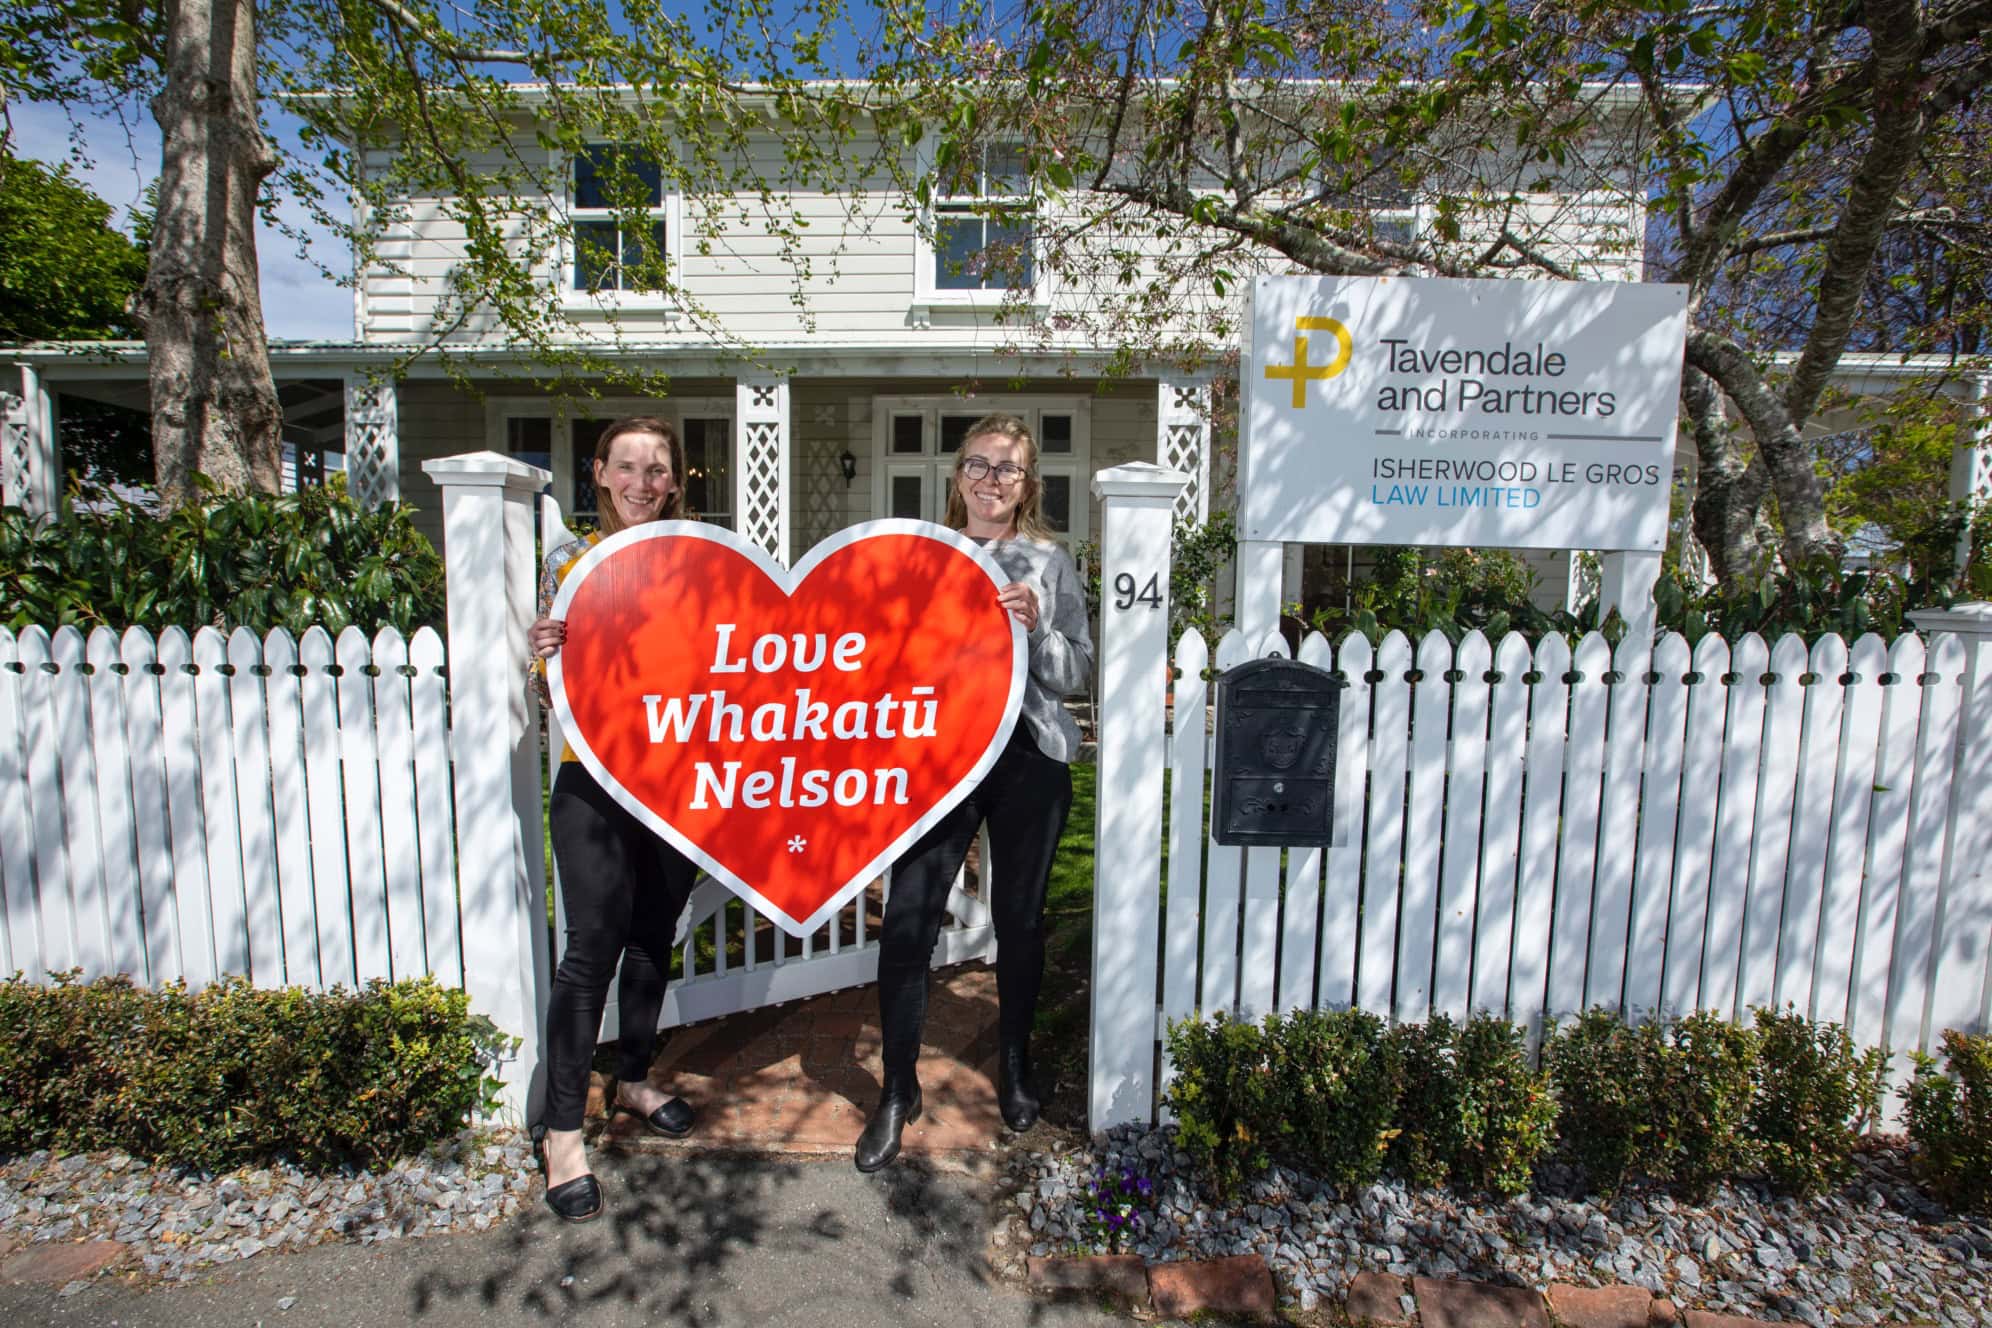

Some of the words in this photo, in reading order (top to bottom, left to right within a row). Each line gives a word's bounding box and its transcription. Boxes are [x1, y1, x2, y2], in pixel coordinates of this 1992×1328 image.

[1379, 339, 1567, 377] Tavendale
[1377, 379, 1447, 412] and
[1458, 380, 1616, 417] Partners
[1409, 428, 1540, 442] INCORPORATING
[1373, 457, 1537, 484] ISHERWOOD
[1547, 463, 1576, 484] LE
[1586, 463, 1660, 486] GROS
[1372, 484, 1429, 506] LAW
[1437, 485, 1541, 509] LIMITED
[1114, 572, 1163, 610] 94
[709, 623, 866, 674] Love
[642, 686, 938, 744] Whakatū
[689, 757, 910, 810] Nelson
